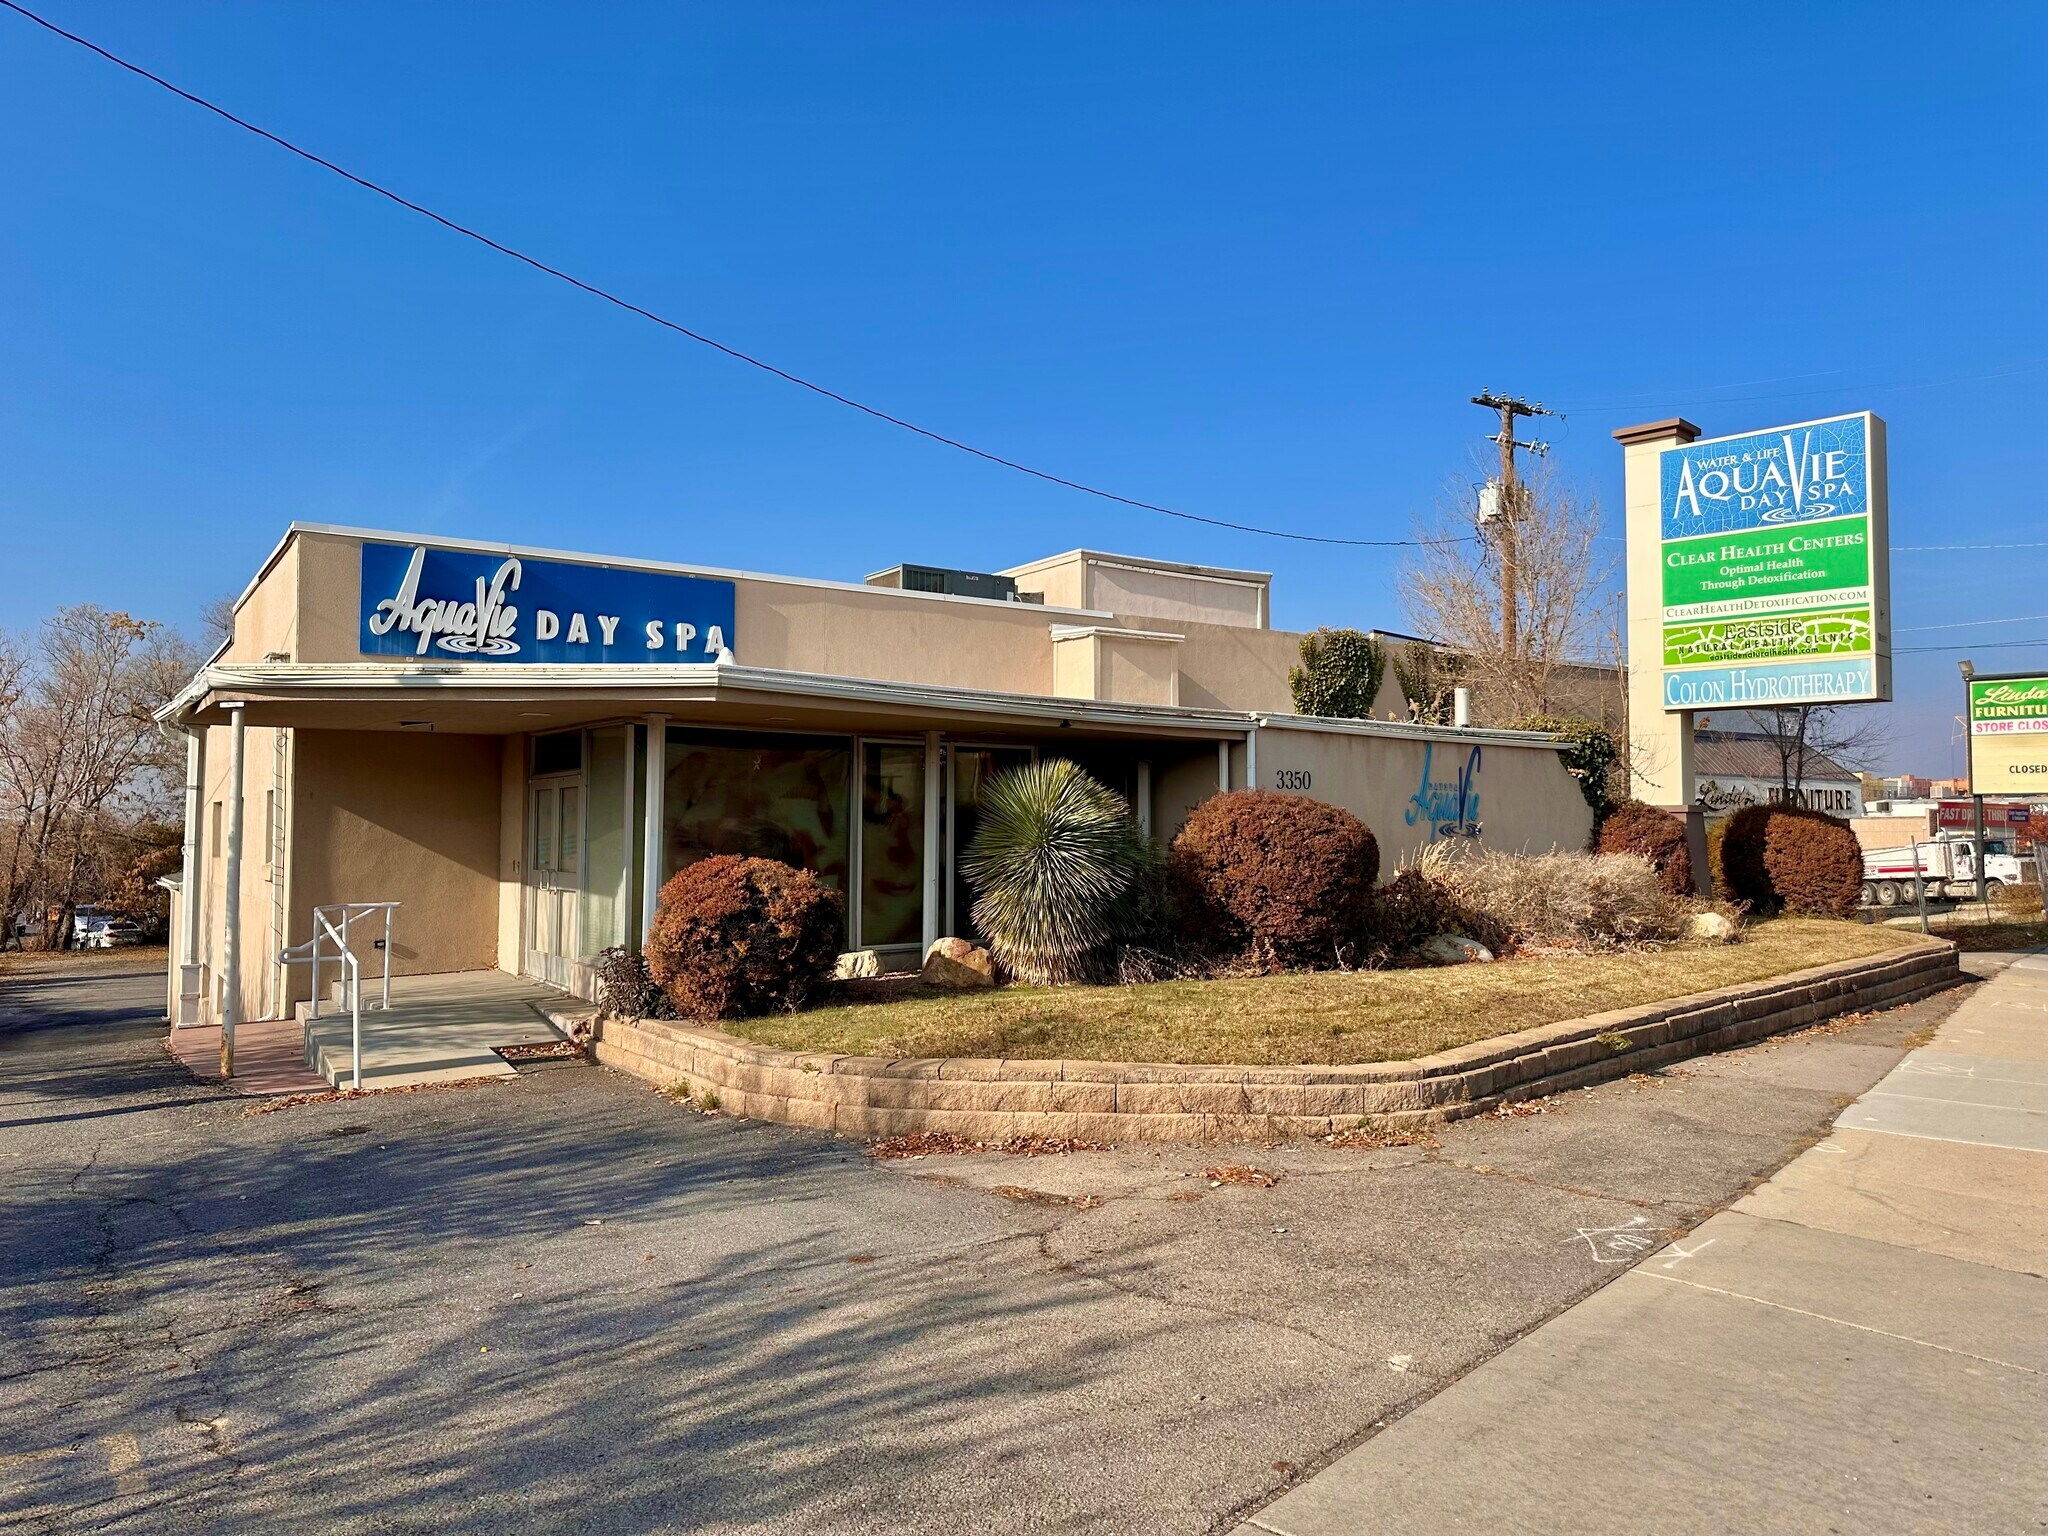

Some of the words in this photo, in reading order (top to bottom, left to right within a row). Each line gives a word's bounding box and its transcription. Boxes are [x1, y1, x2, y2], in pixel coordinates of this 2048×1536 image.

[1697, 455, 1737, 469] WATER
[1742, 452, 1751, 462] &
[1757, 448, 1780, 460] LIFE
[1741, 489, 1788, 511] DAY
[1808, 481, 1854, 501] SPA
[1667, 552, 1715, 567] CLEAR
[1720, 543, 1784, 561] HEALTH
[1788, 533, 1864, 553] CENTERS
[1720, 562, 1764, 577] Optimal
[1767, 558, 1804, 571] Health
[1700, 578, 1746, 592] Through
[1748, 569, 1826, 586] Detoxification
[536, 610, 620, 646] DAY
[646, 620, 724, 654] SPA
[1725, 618, 1802, 640] Eastside
[1679, 642, 1734, 654] NATURAL
[1745, 637, 1794, 649] HEALTH
[1806, 632, 1854, 644] CLINIC
[1710, 647, 1819, 661] eastsidenaturalhealth.com
[1667, 675, 1724, 705] COLON
[1730, 670, 1869, 701] HYDROTHERAPY
[1976, 721, 2013, 733] STORE
[2009, 764, 2048, 774] CLOSED
[1276, 770, 1311, 790] 3350
[1940, 807, 1960, 821] FAST
